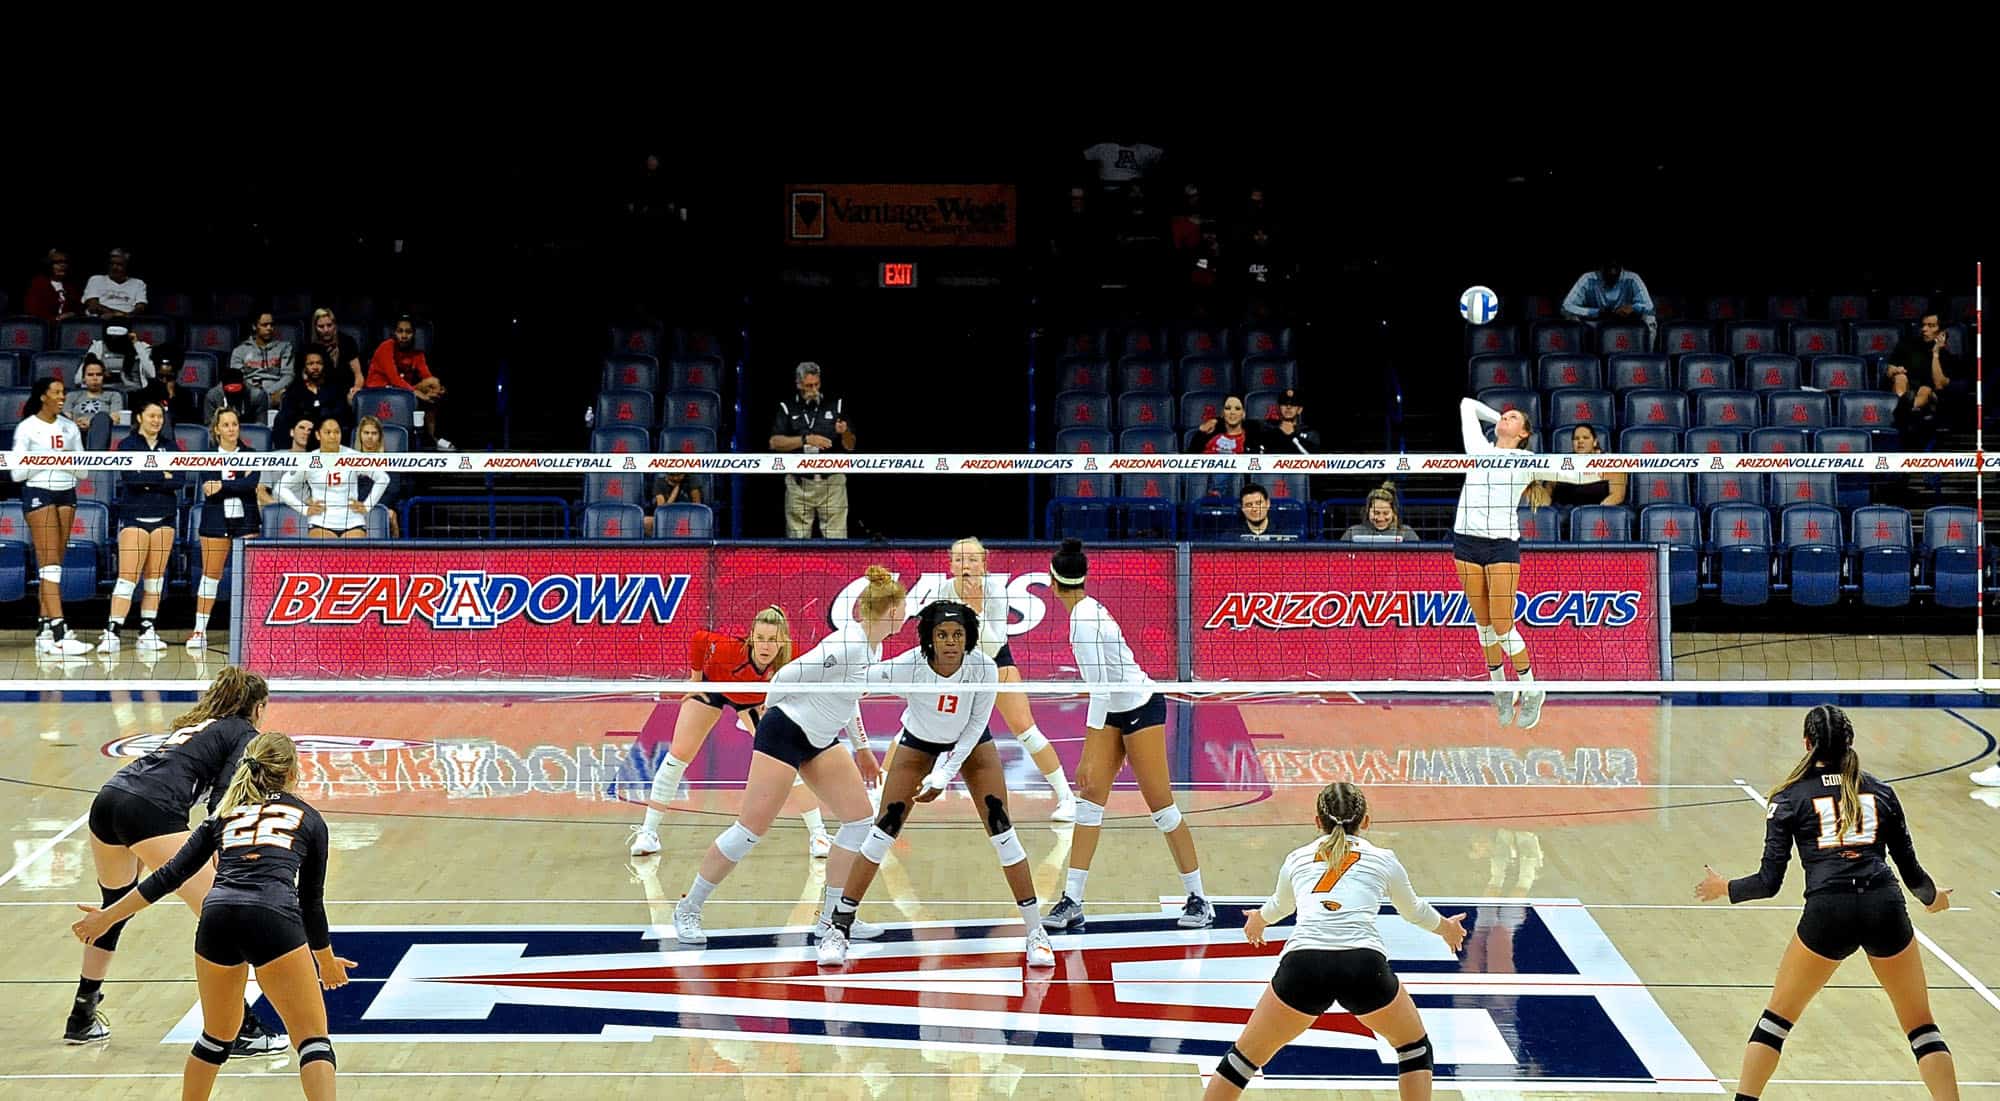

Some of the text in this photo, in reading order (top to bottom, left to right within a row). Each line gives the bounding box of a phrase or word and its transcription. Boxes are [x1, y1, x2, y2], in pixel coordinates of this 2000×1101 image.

[885, 263, 913, 285] EXIT
[51, 435, 64, 449] 16
[328, 472, 341, 487] 15
[266, 573, 444, 624] BEAR
[486, 573, 690, 624] DOWN
[829, 572, 1053, 636] CAS
[937, 694, 959, 714] 13
[221, 803, 304, 850] 22
[1812, 793, 1878, 850] 10
[1312, 850, 1361, 894] 7
